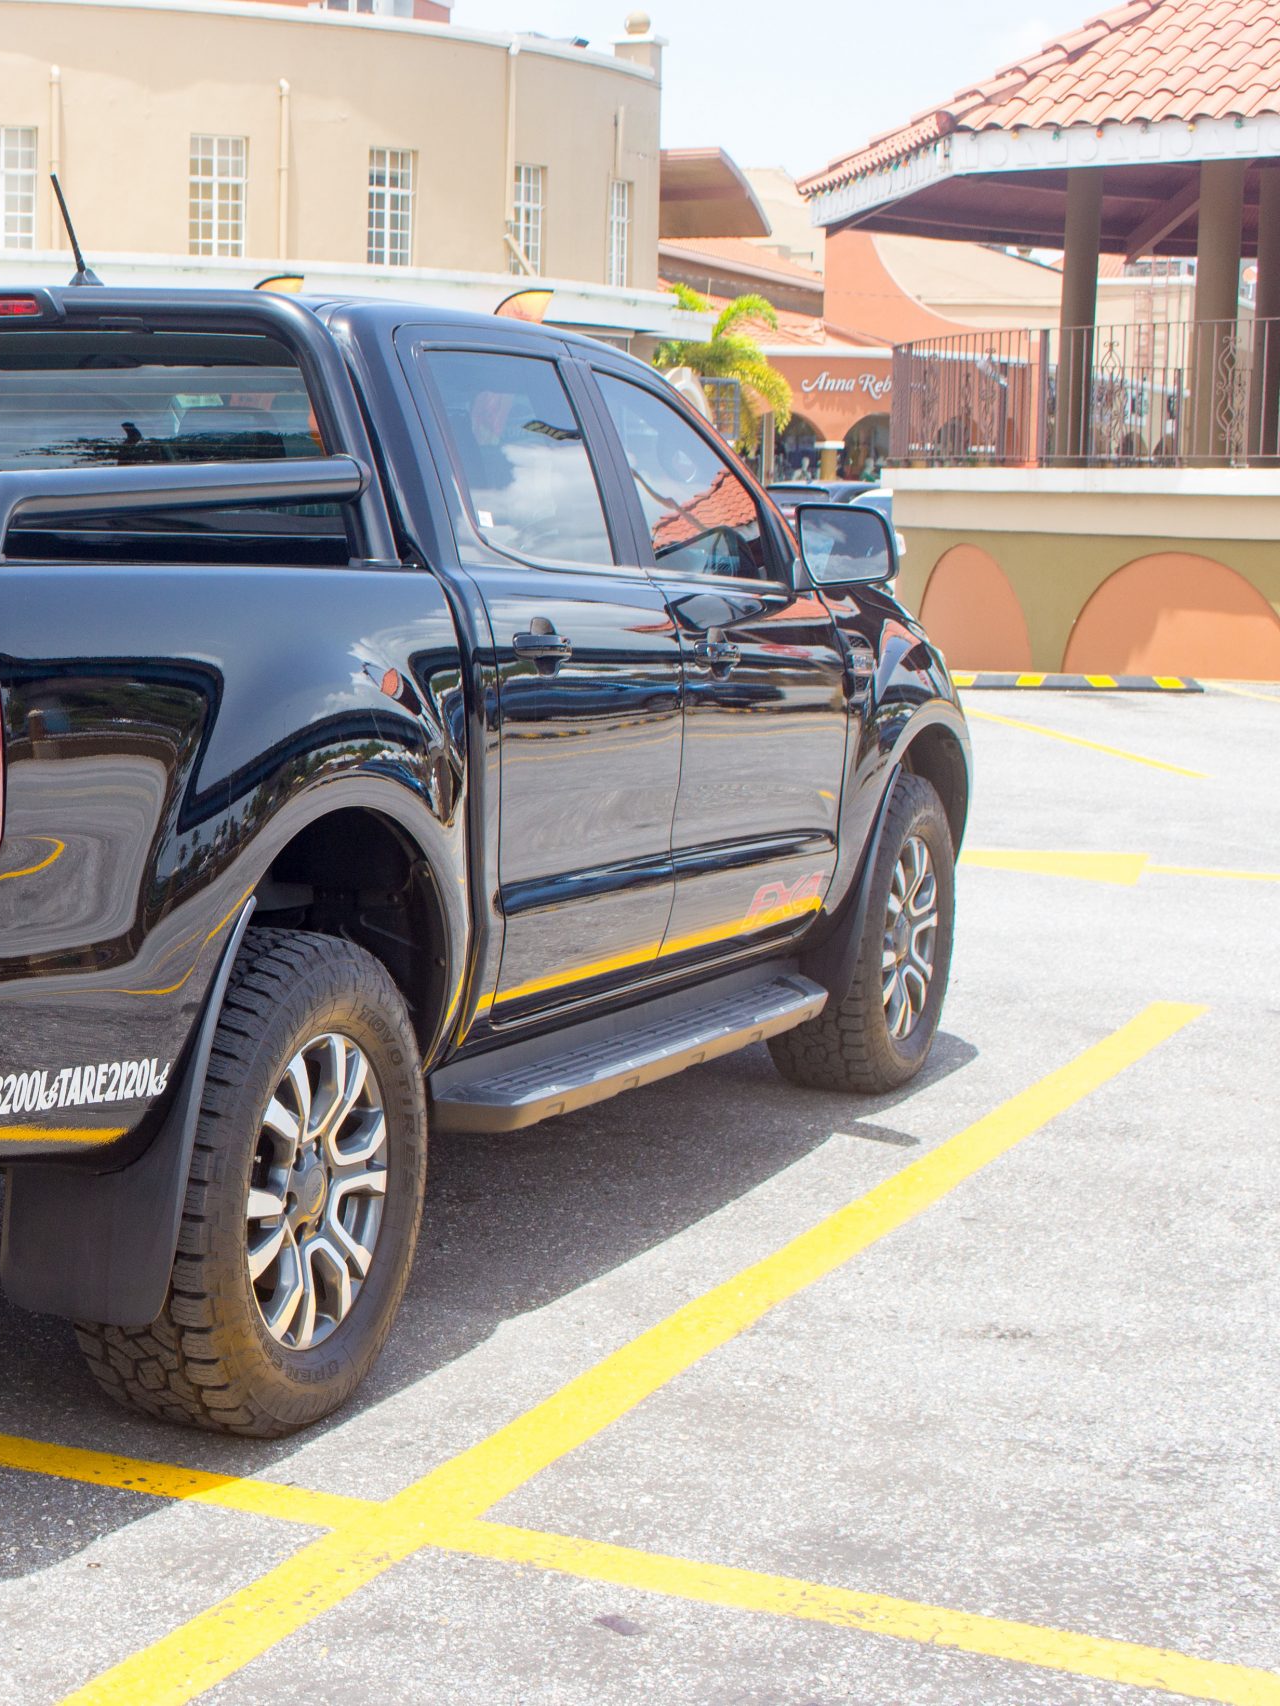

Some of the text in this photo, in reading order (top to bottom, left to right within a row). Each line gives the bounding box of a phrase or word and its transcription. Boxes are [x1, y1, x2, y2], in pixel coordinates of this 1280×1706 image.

[801, 371, 893, 400] Anna Reb
[740, 869, 825, 930] FX4
